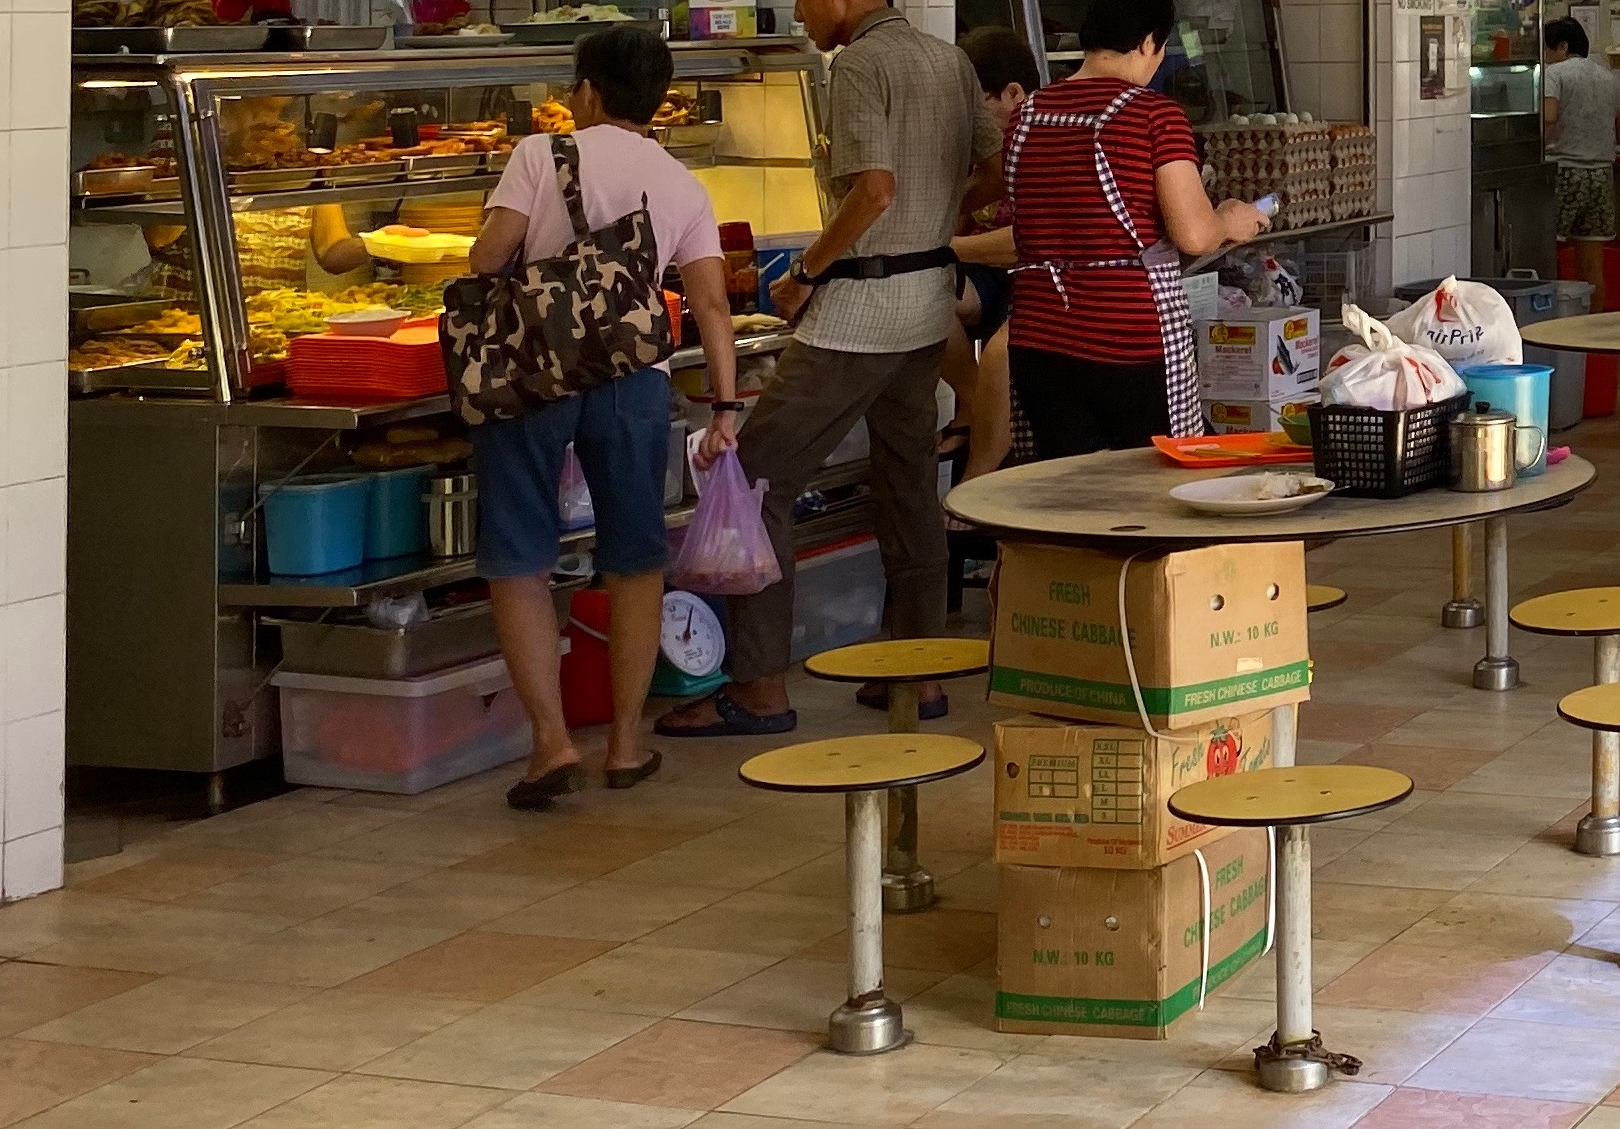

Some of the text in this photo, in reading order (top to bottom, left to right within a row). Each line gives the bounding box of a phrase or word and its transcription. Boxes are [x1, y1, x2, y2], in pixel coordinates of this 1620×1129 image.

[1048, 581, 1091, 606] FRESH
[1011, 612, 1066, 640] CHINESE
[1246, 626, 1260, 642] 10
[1264, 621, 1279, 638] KG
[1184, 669, 1302, 708] FRESH CHINESE CABBAGE
[1215, 855, 1243, 889] FRESH
[1074, 951, 1089, 965] 10
[1095, 950, 1114, 966] KG
[1006, 1001, 1146, 1021] FRESH CHINESE CABBAGE
